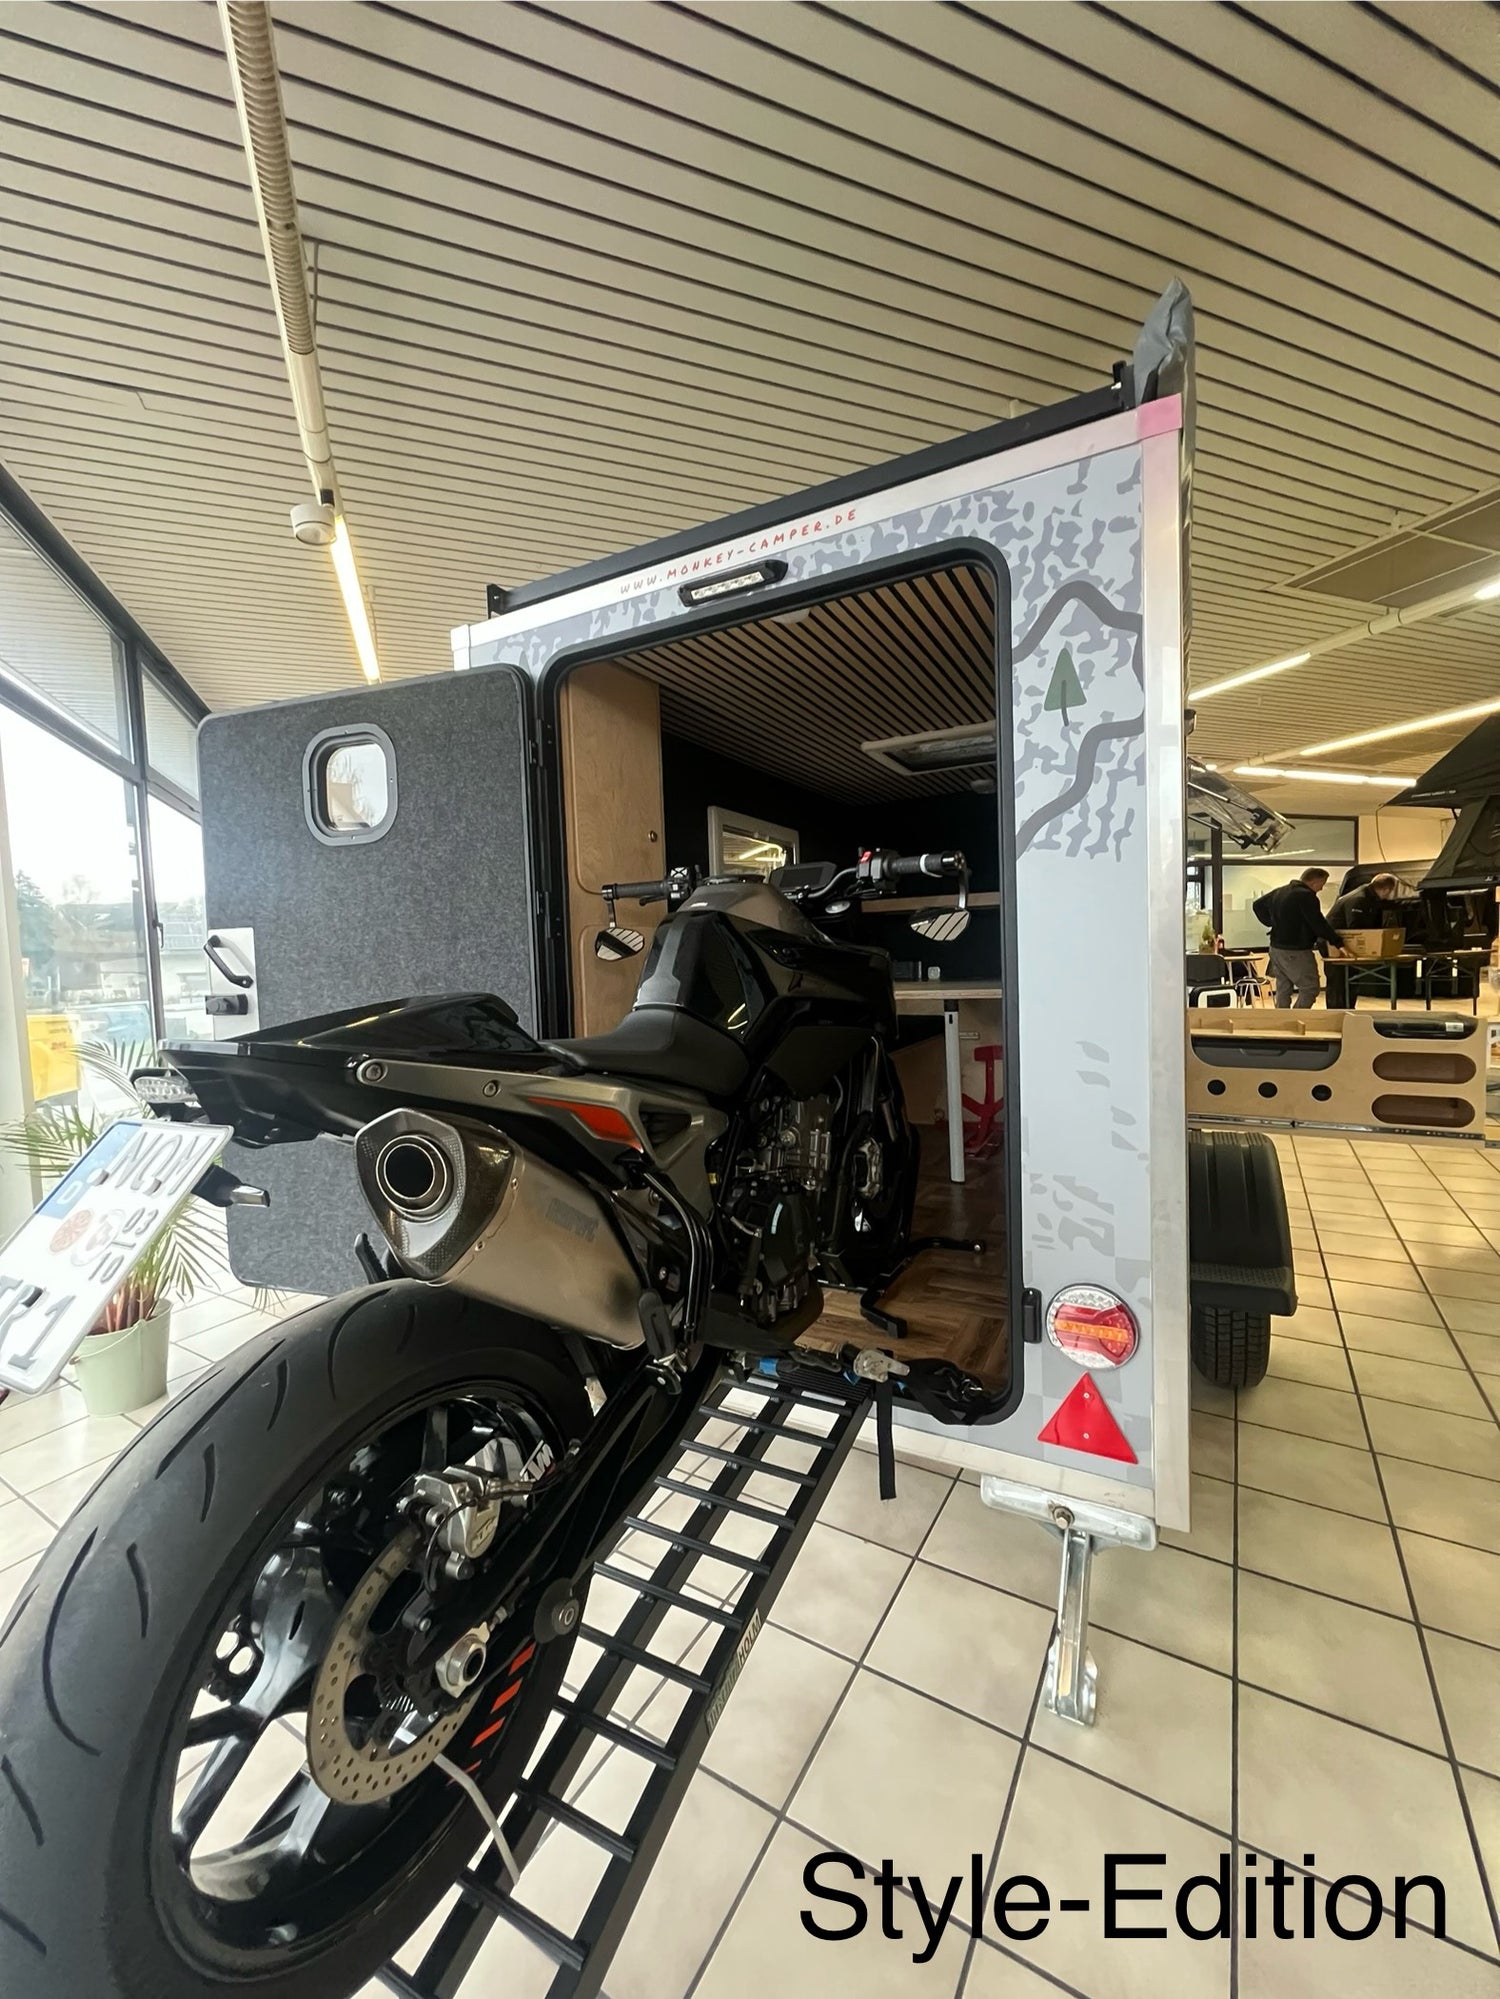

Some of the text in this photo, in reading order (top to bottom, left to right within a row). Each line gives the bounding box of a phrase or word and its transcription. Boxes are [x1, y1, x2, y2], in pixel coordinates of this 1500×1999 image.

[60, 1179, 81, 1206] D
[122, 1206, 160, 1236] 03
[88, 1250, 124, 1284] 10
